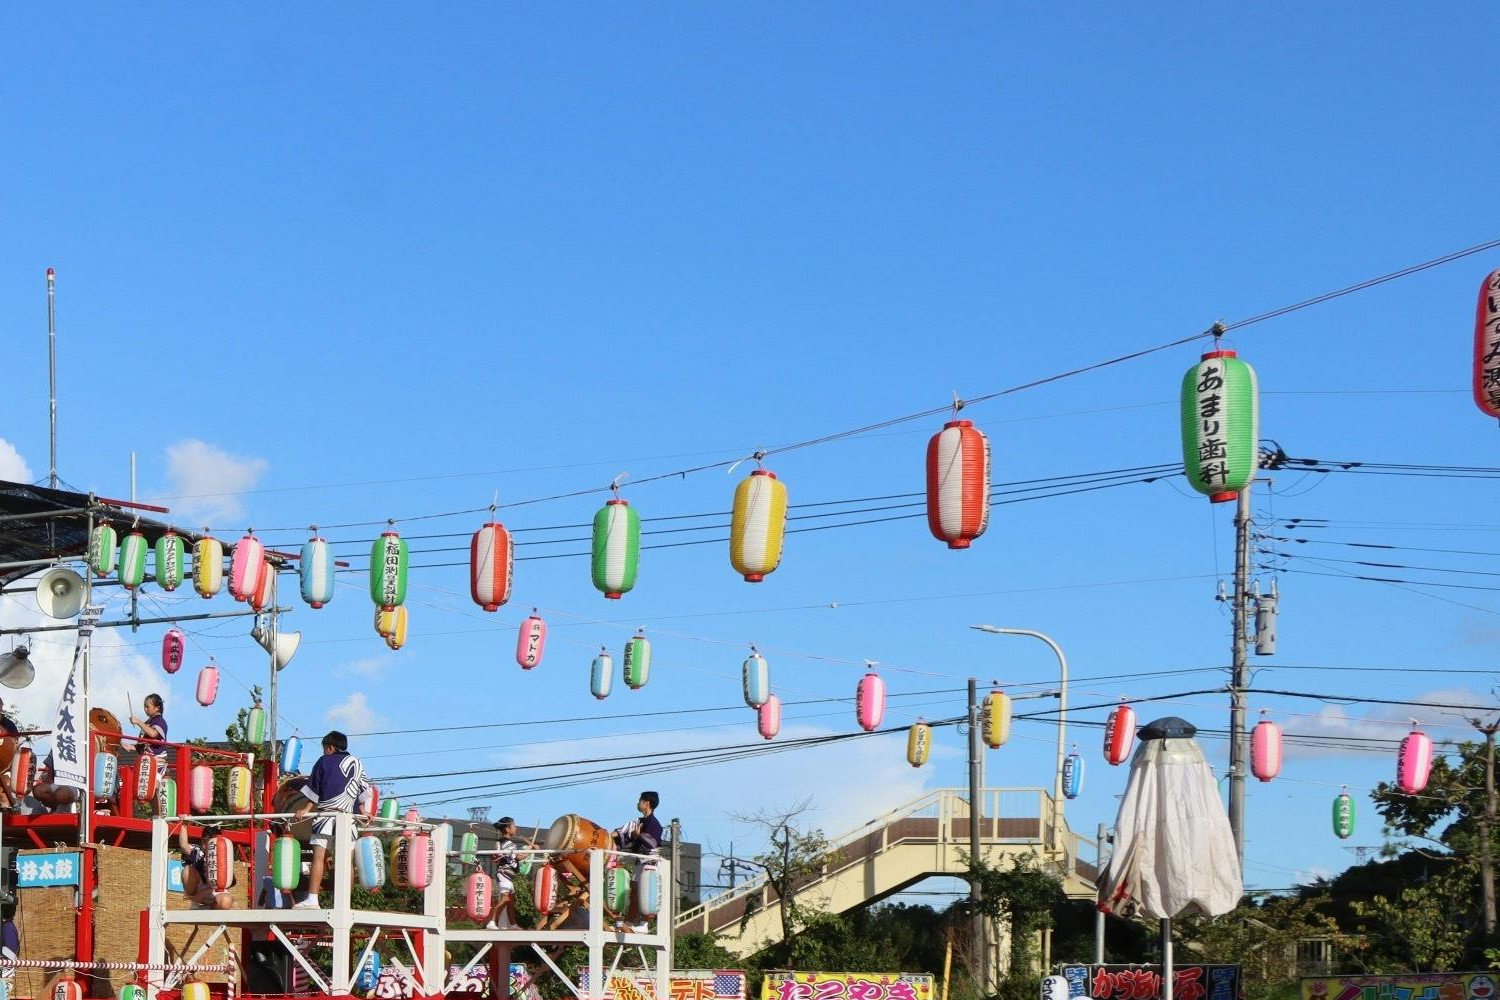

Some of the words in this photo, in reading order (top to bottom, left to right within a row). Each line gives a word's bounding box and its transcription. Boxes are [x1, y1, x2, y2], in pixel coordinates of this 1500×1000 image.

[1196, 365, 1229, 485] あまり歯科
